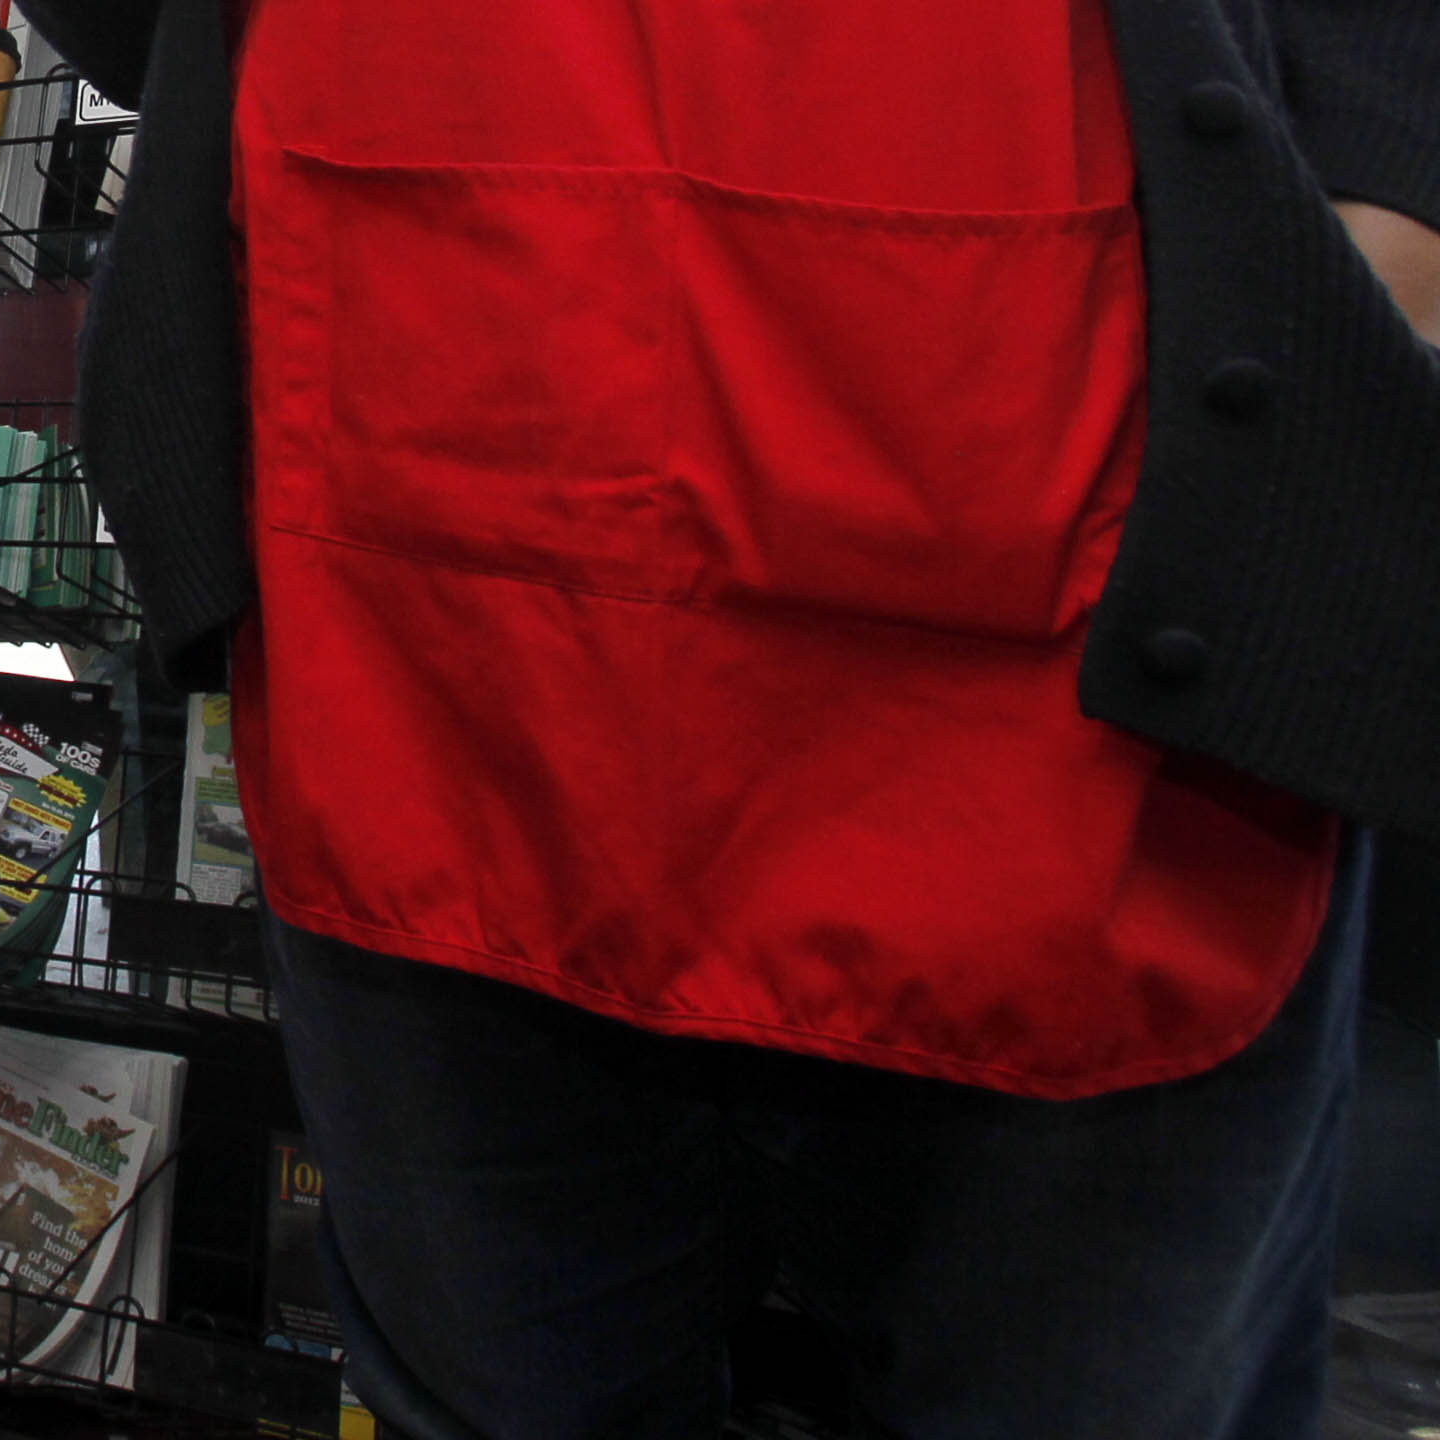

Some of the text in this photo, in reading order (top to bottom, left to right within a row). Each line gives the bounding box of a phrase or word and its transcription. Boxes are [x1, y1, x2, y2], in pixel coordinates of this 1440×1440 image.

[31, 1210, 89, 1250] Find the
[27, 1249, 43, 1266] of
